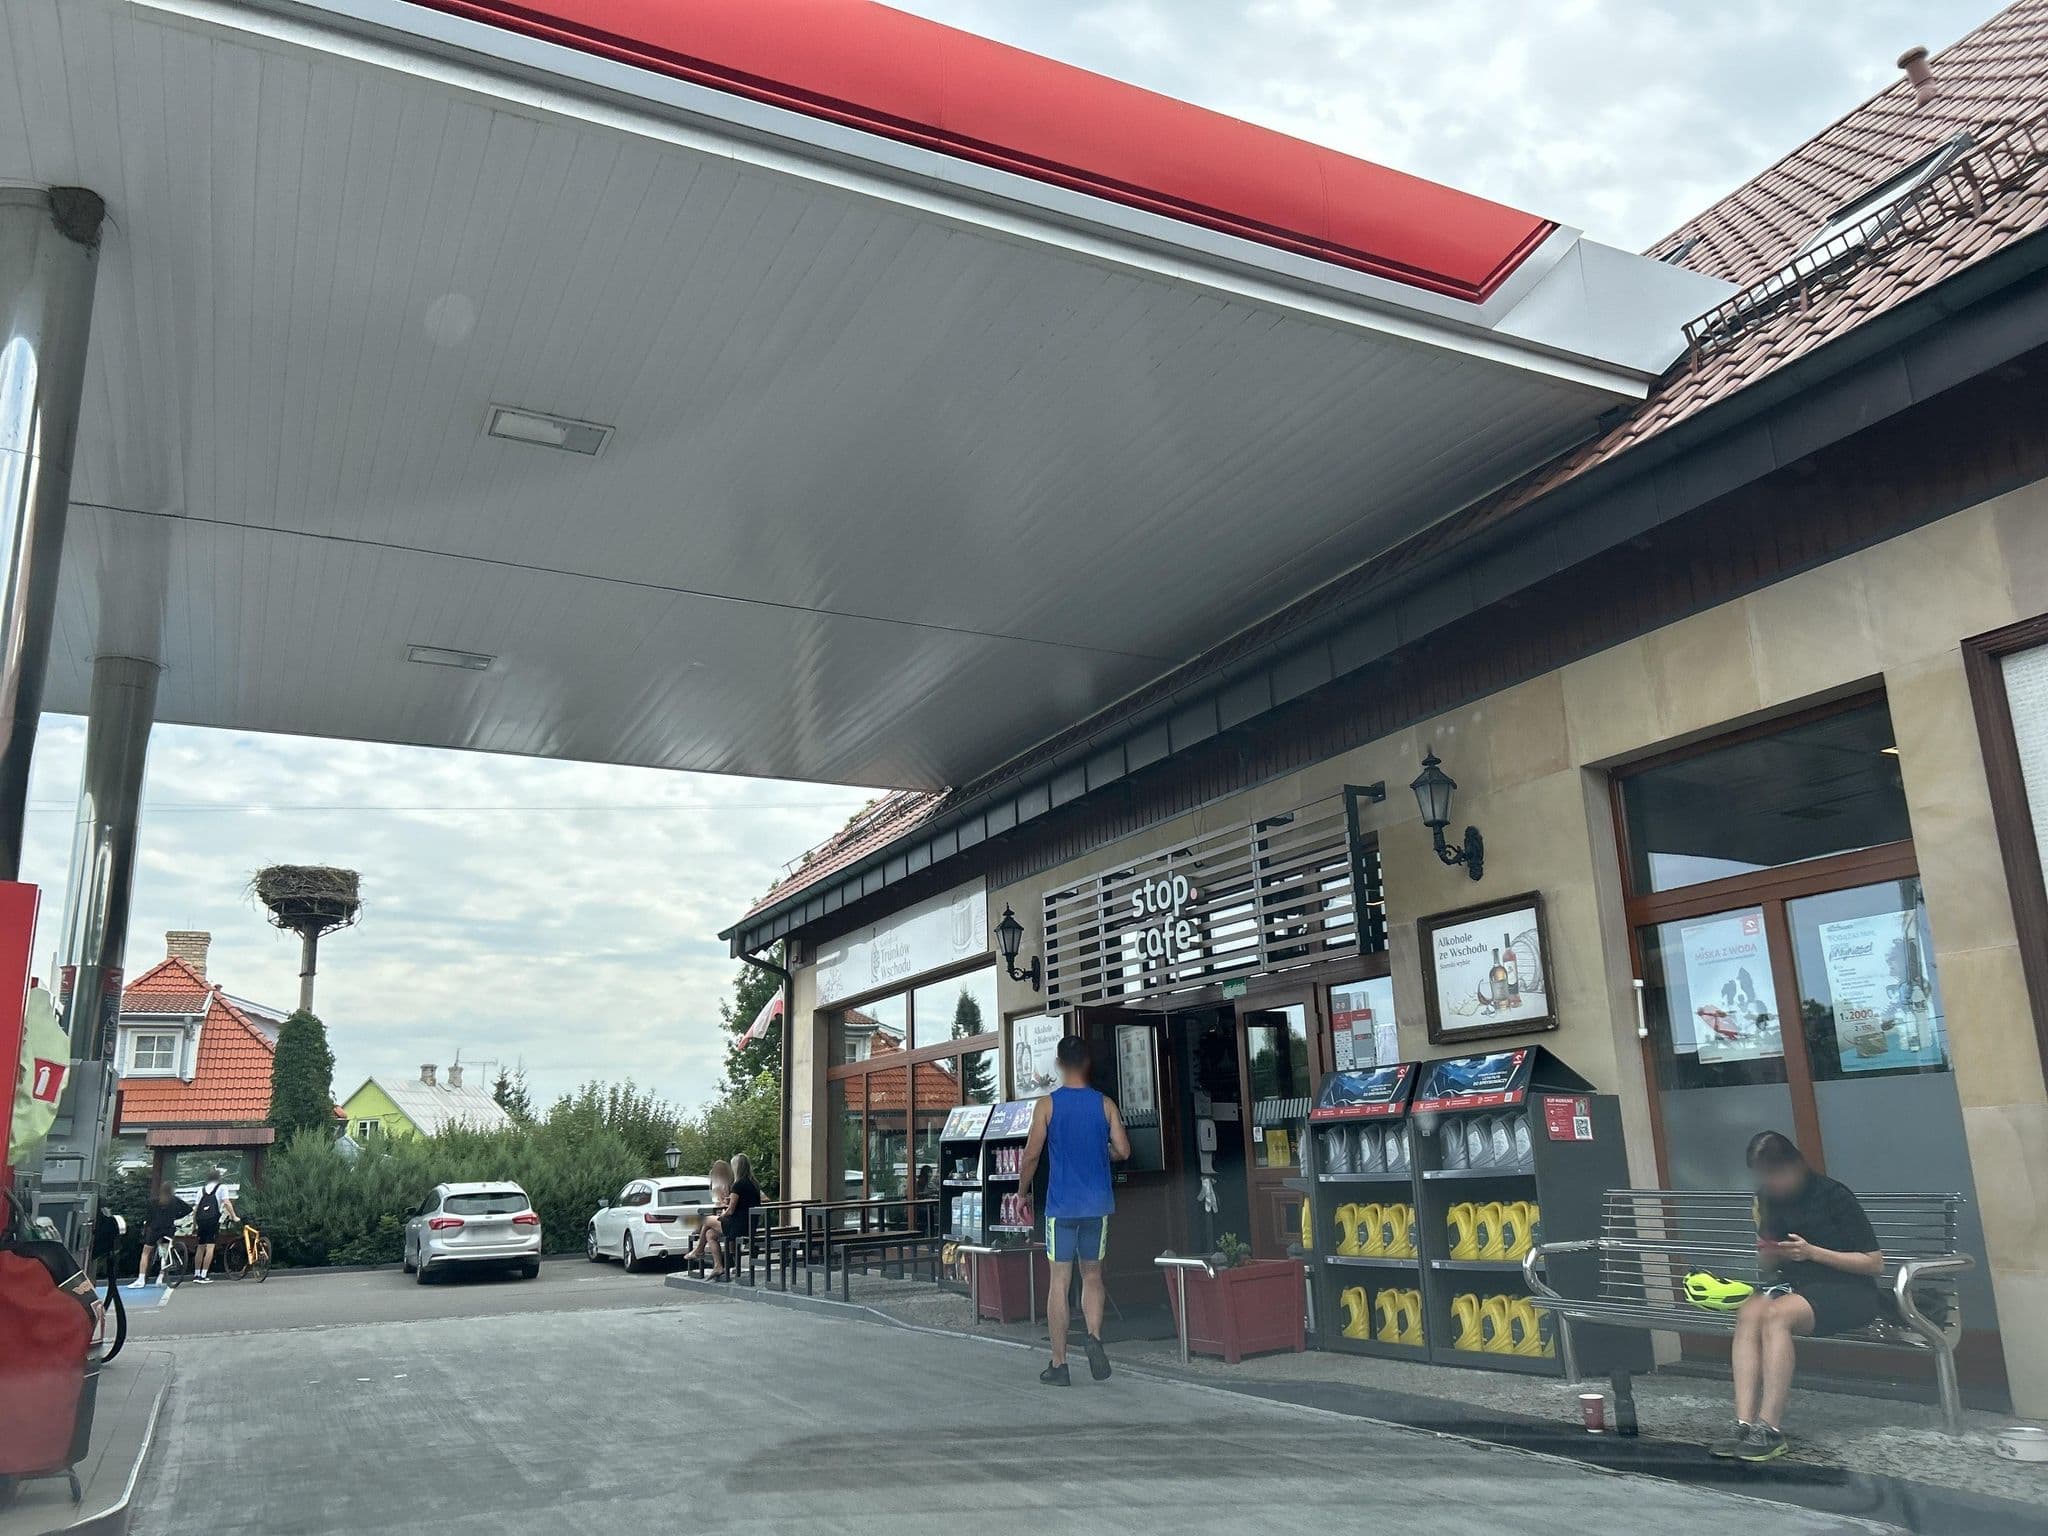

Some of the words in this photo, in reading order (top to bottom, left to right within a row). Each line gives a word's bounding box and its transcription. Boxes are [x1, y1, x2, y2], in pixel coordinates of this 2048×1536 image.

[1135, 915, 1191, 960] cafe
[1439, 933, 1473, 946] Alkohole
[1450, 943, 1488, 957] Wschodu
